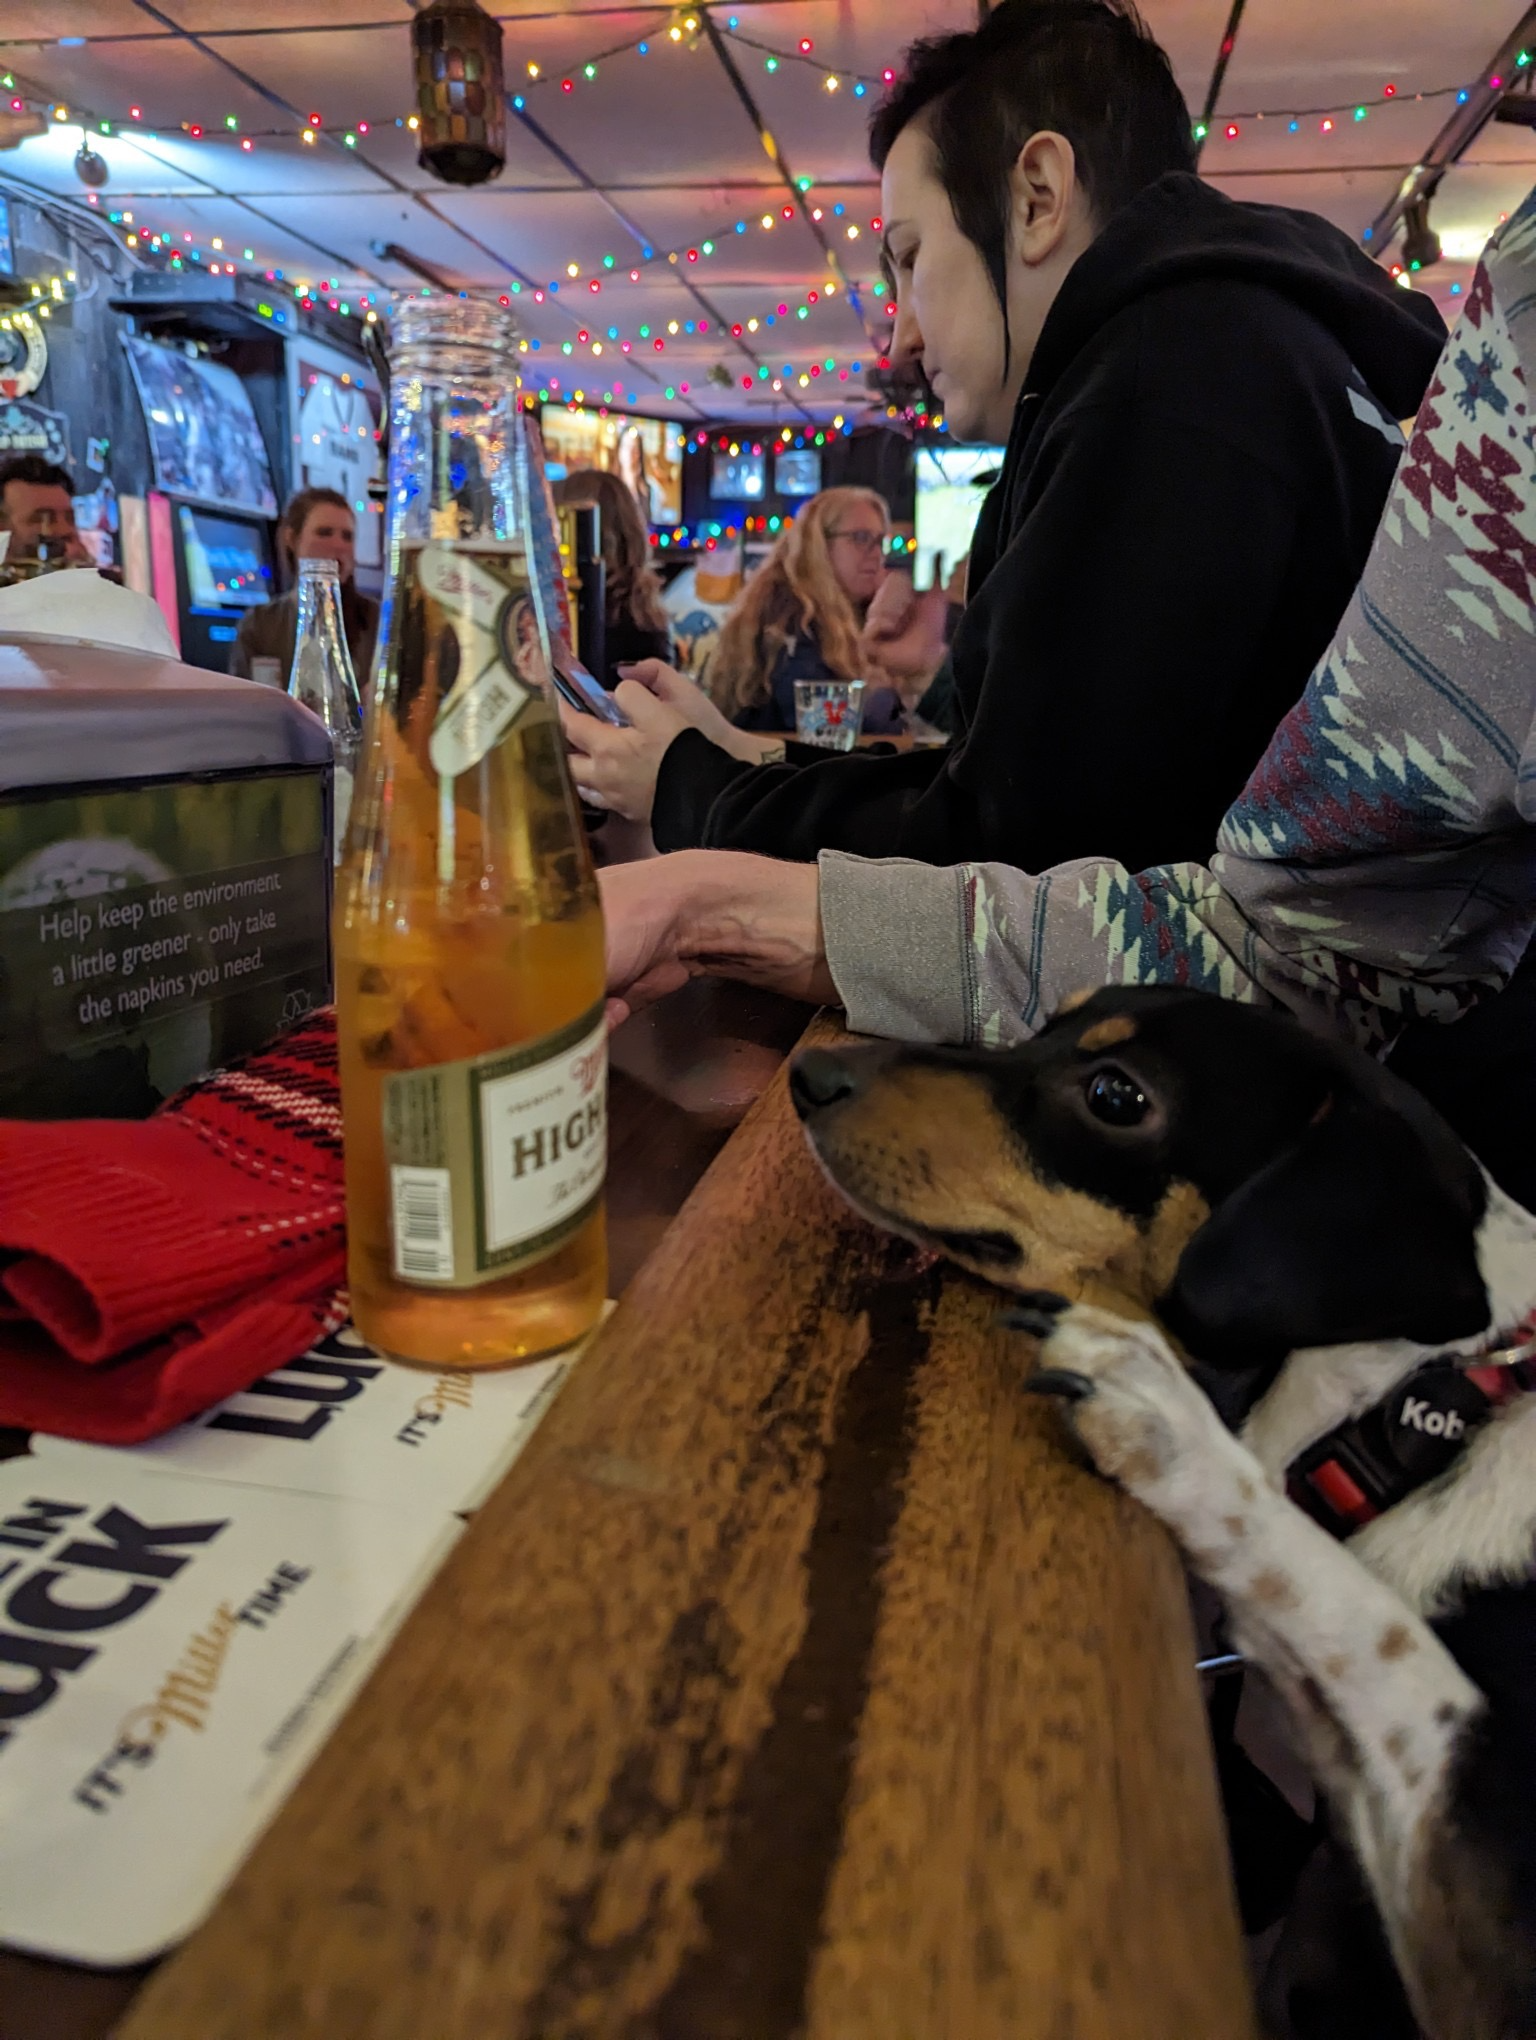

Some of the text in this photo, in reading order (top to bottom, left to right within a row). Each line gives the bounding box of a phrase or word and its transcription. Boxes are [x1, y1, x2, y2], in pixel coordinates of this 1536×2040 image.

[39, 871, 282, 942] Help keep the environment
[52, 966, 65, 986] a
[71, 949, 116, 981] little
[122, 931, 193, 976] greener
[208, 915, 243, 946] only
[246, 908, 277, 934] take
[79, 994, 113, 1024] the
[118, 975, 185, 1014] napkins
[190, 963, 219, 997] you
[0, 1504, 231, 1751] UCK
[117, 1600, 238, 1737] Miller
[235, 1560, 314, 1630] TIME
